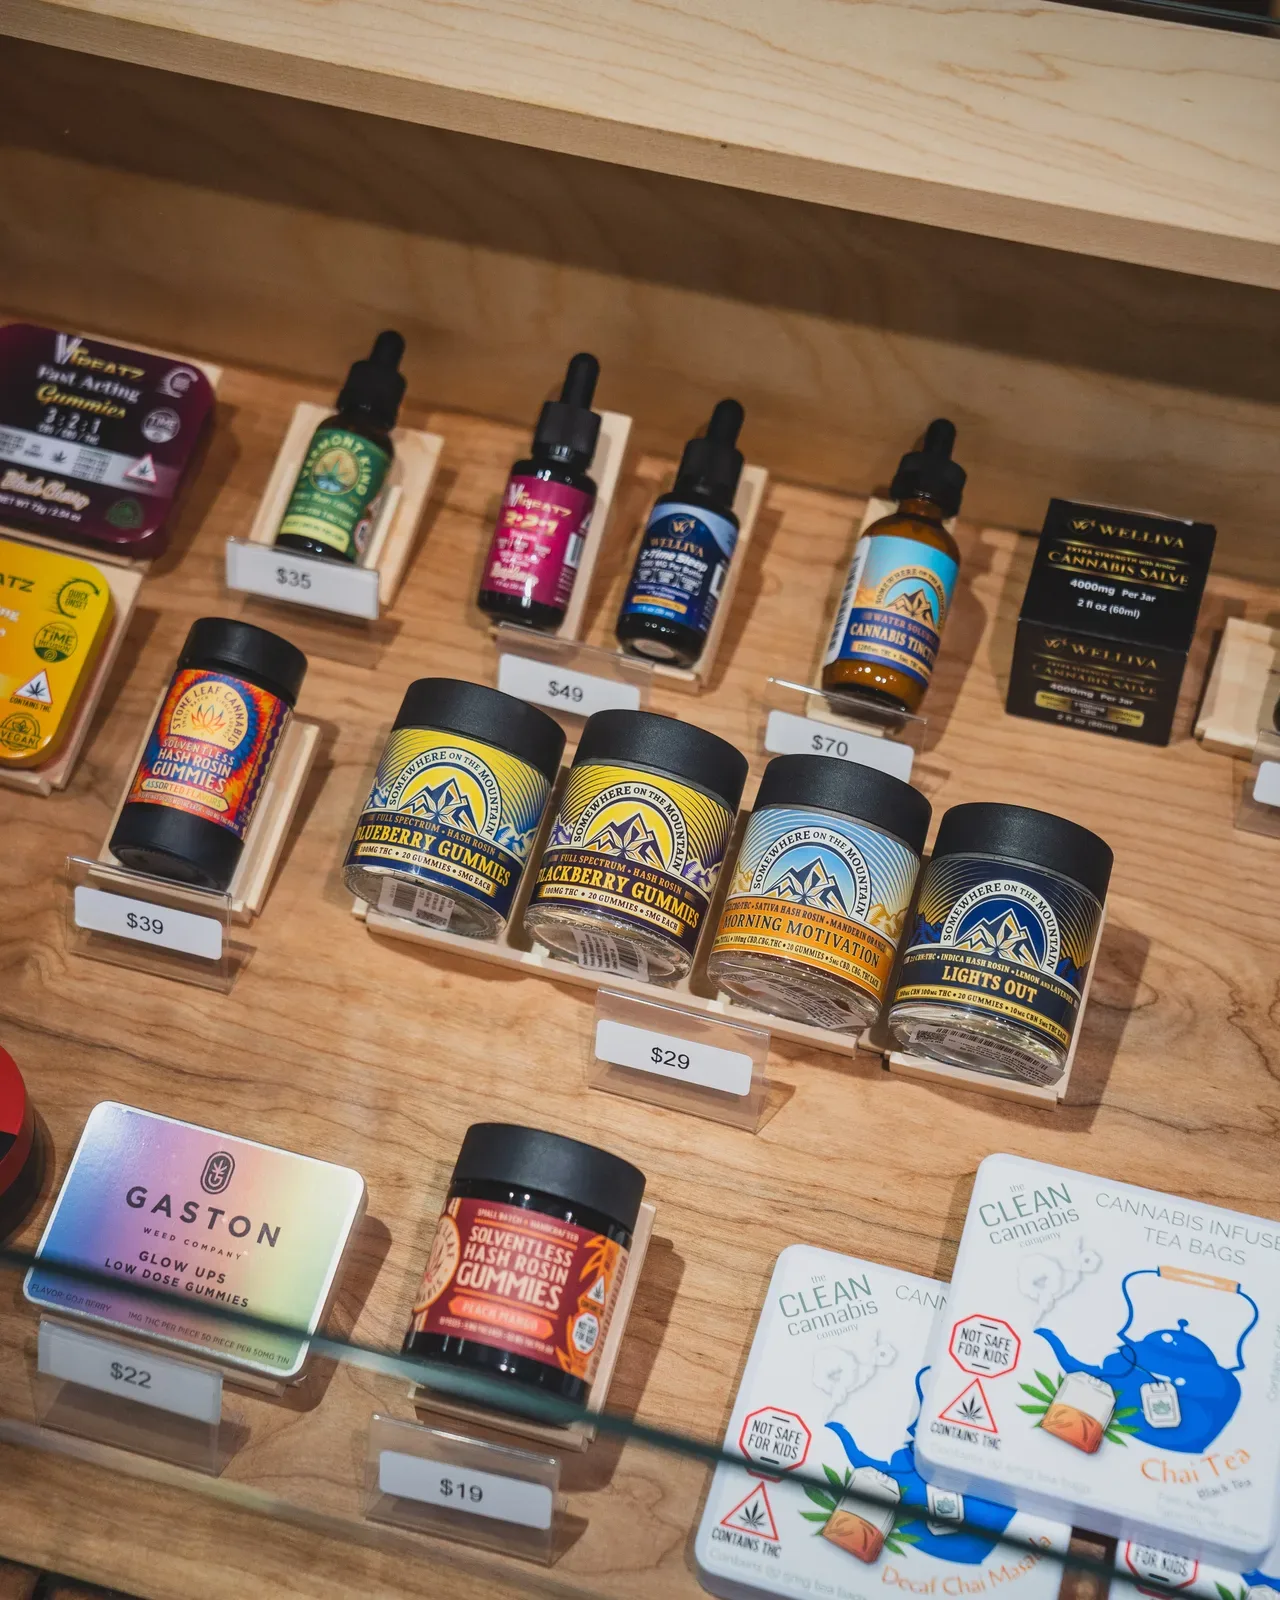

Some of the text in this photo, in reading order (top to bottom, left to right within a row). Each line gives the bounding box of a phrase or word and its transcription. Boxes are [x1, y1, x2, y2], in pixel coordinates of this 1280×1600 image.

[37, 364, 76, 387] Fast
[37, 383, 126, 419] Gummies
[1099, 523, 1185, 549] WELLIVA
[1048, 551, 1189, 587] CANNABIS SALVE
[1066, 546, 1137, 564] EXTRA STRENGTH
[276, 567, 312, 590] $35
[1070, 578, 1157, 603] 4000mg Per Jar
[65, 597, 88, 610] ONSET
[67, 588, 90, 602] QUICK
[1077, 598, 1141, 619] 2 fl oz (60ml)
[850, 623, 906, 647] CANNABIS
[872, 612, 906, 629] WATER
[1071, 644, 1158, 670] WELLIVA
[9, 697, 40, 712] CONTAINS
[547, 679, 585, 703] $49
[173, 685, 244, 747] STONE LEAF CANNABIS
[1, 730, 36, 746] VEGAN
[162, 739, 235, 766] SOLVENTLESS
[810, 734, 850, 758] $70
[151, 760, 227, 793] GUMMIES
[158, 748, 232, 777] HASH ROSIN
[145, 780, 185, 795] ASSORTED
[186, 788, 223, 808] FLAVORS
[389, 750, 499, 836] SOMEWHERE ON THE MOUNTAIN
[376, 814, 496, 856] FULL SPECTRUM HASH ROSIN
[573, 785, 687, 872] SOMEWHERE ON THE MOUNTAIN
[356, 825, 511, 888] BLUEBERRY GUMMIES
[379, 846, 491, 892] THC 20 GUMMIES 5MG EACH
[560, 853, 682, 895] FULL SPECTRUM HASH ROSIN
[753, 829, 868, 917] SOMEWHERE ON THE MOUNTAIN
[544, 886, 679, 931] 100MG THC 20 GUMMIES 5MG EACH
[631, 881, 700, 929] GUMMIES
[754, 901, 779, 913] SATIVA
[780, 905, 801, 917] HASH
[802, 910, 826, 924] ROSIN
[829, 918, 867, 941] MANDERIN
[126, 912, 164, 935] $39
[943, 882, 1058, 970] SOMEWHERE ON THE MOUNTAIN
[723, 913, 880, 969] MORNING MOTIVATION
[786, 942, 839, 966] 20 GUMMIES 5MG
[940, 953, 1040, 985] INDICA HASH ROSIN LEMON
[941, 965, 1038, 1004] LIGHTS OUT
[938, 989, 1059, 1035] THC 20 GUMMIES 10MG CBN THC
[651, 1046, 690, 1070] $29
[1009, 1182, 1025, 1193] the
[126, 1185, 282, 1248] GASTON
[978, 1182, 1072, 1228] CLEAN
[1095, 1192, 1204, 1232] CANNABIS
[990, 1205, 1080, 1247] cannabis
[1019, 1231, 1061, 1249] company
[143, 1227, 242, 1261] WEED COMPANY
[469, 1226, 574, 1268] SOLVENTLESS
[1143, 1226, 1246, 1265] TEA BAGS
[138, 1250, 227, 1285] GLOW UPS
[464, 1243, 569, 1287] HASH ROSIN
[811, 1273, 826, 1284] the
[104, 1257, 250, 1308] LOW DOSE GUMMIES
[456, 1261, 564, 1311] GUMMIES
[778, 1274, 872, 1319] CLEAN
[84, 1297, 290, 1365] BERRY THC PER PIECE PIECE PER TIN
[787, 1298, 878, 1337] cannabis
[816, 1323, 858, 1341] company
[958, 1340, 1009, 1366] FOR KIDS
[960, 1327, 1012, 1352] NOT SAFE
[110, 1361, 152, 1390] $22
[748, 1434, 799, 1460] FOR KIDS
[752, 1420, 803, 1445] NOT SAFE
[930, 1421, 1002, 1451] CONTAINS THC
[1140, 1448, 1251, 1485] Chai Tea
[439, 1478, 484, 1503] $19
[712, 1529, 782, 1559] CONTAINS THC
[1133, 1550, 1157, 1568] FOR
[881, 1564, 936, 1595] Decaf
[943, 1570, 986, 1597] Chai
